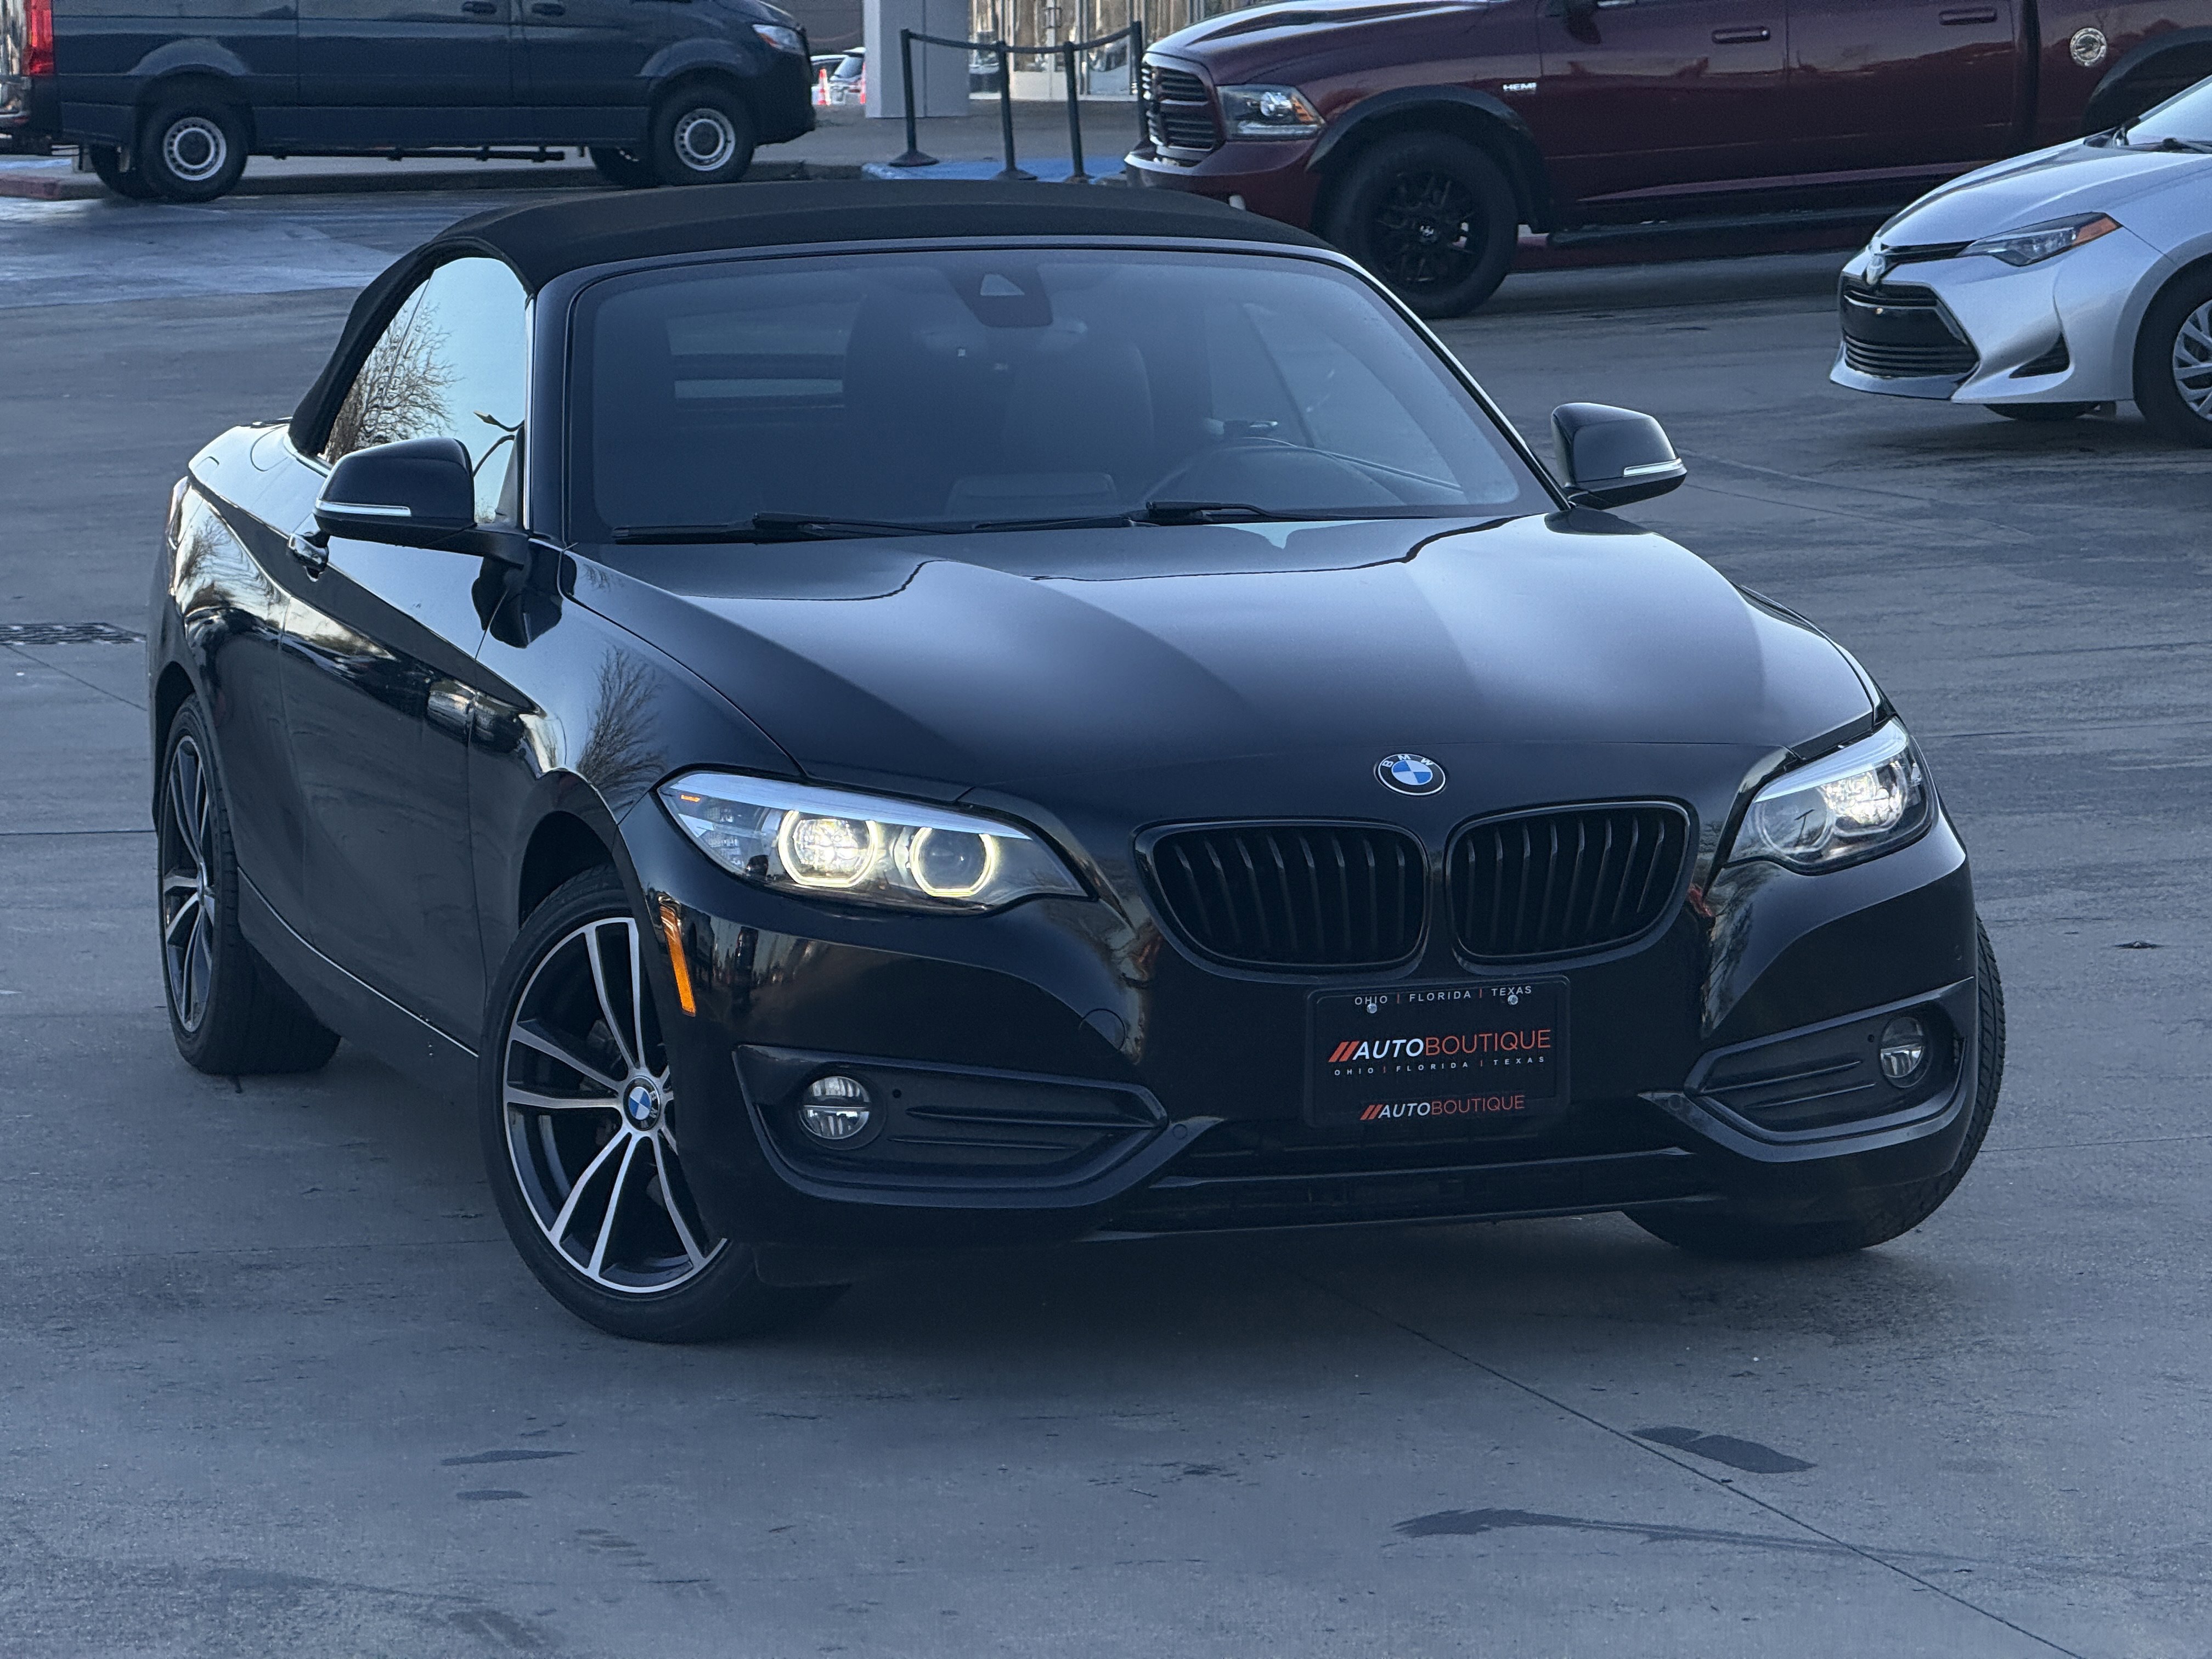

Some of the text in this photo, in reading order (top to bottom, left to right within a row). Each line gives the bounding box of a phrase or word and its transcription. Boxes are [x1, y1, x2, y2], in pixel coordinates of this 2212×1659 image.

[1381, 754, 1434, 768] BMW
[1355, 985, 1532, 1006] OHIO FLORIDA TEXAS
[1334, 1056, 1544, 1076] OHIO FLORIDA TEXAS
